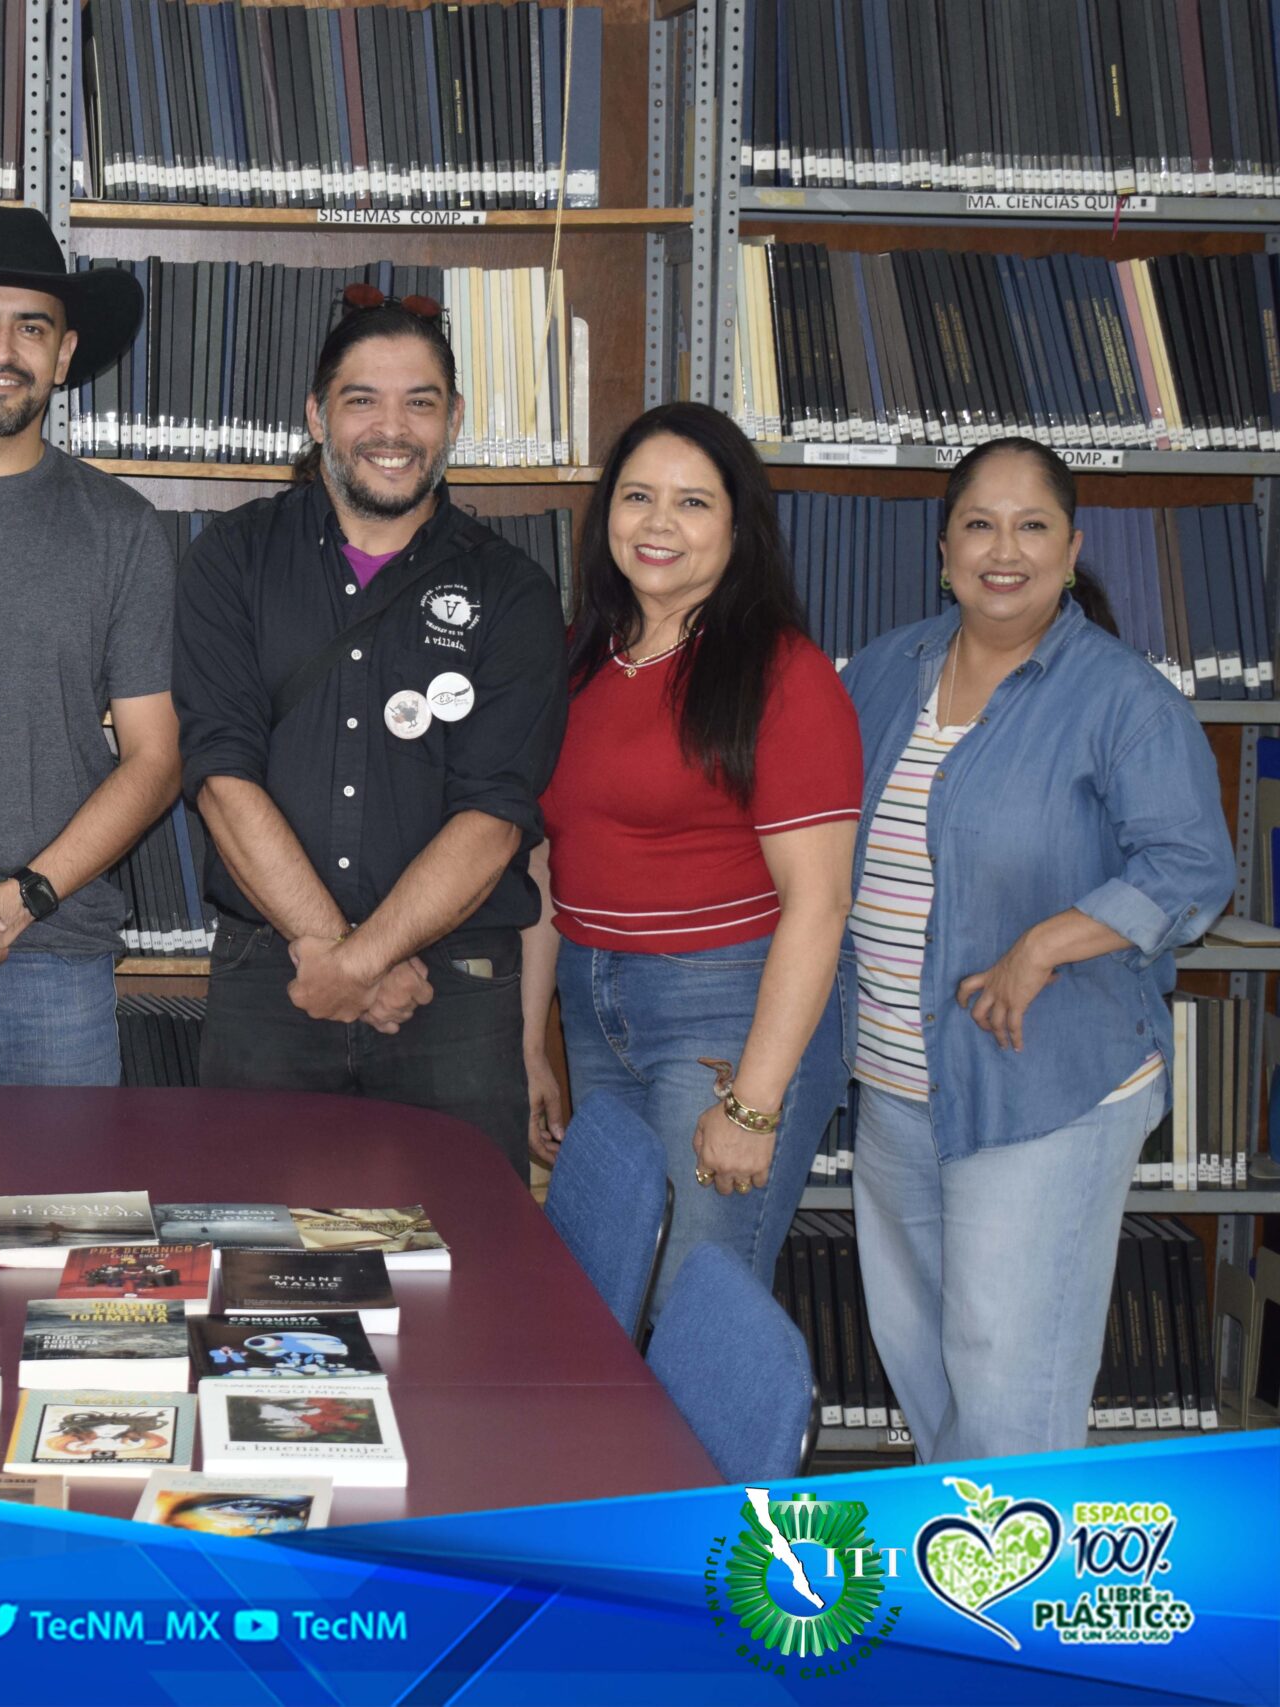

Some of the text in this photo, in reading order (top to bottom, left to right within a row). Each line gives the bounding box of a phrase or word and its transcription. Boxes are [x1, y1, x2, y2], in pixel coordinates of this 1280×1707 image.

[967, 196, 1000, 209] MA.
[1006, 195, 1080, 209] CIENCIAS
[319, 208, 466, 226] SISTEMAS COMP.
[268, 1274, 344, 1282] ONLINE
[274, 1280, 340, 1288] MAGIC
[70, 1313, 169, 1323] TORMENTA
